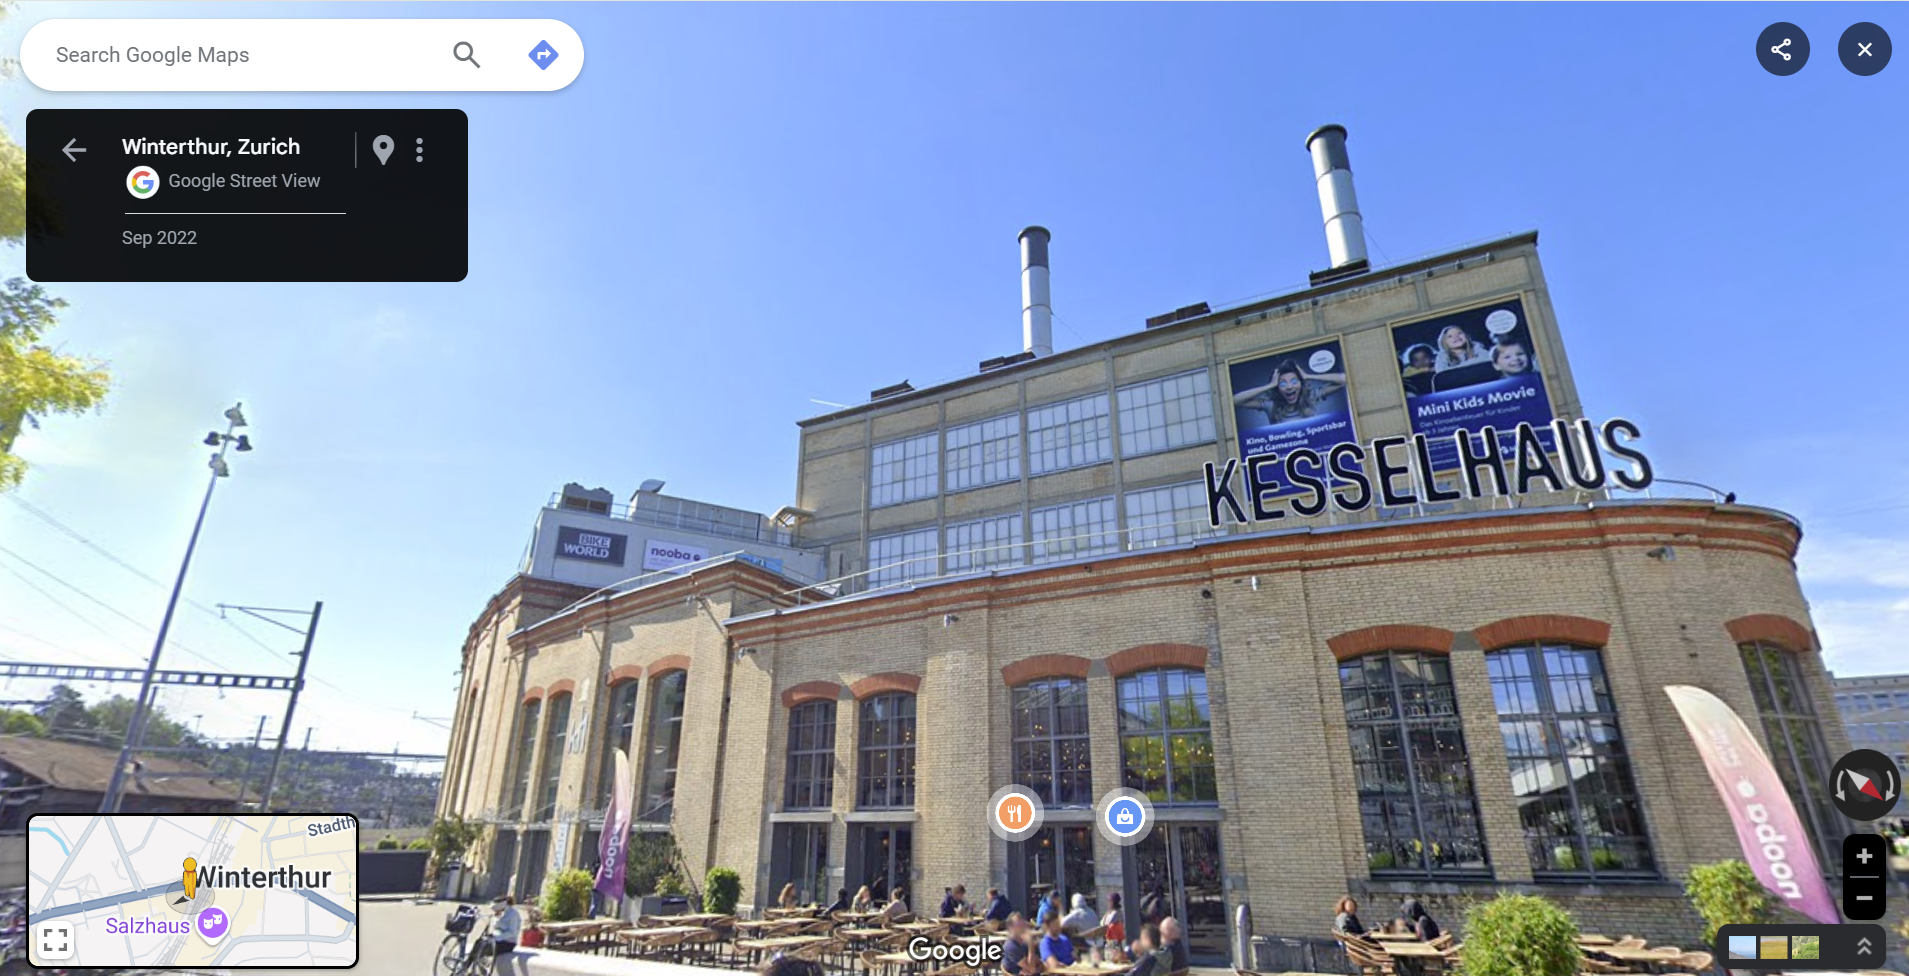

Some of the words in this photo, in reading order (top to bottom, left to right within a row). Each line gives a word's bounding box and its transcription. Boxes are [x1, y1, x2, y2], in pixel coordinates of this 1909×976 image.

[1418, 401, 1451, 418] Mini
[1453, 396, 1484, 411] Kids
[1487, 387, 1536, 404] Movie
[1485, 409, 1496, 417] für
[1497, 404, 1522, 414] Kinder
[1245, 436, 1268, 446] Kino,
[1268, 430, 1306, 442] Bowling,
[1306, 421, 1347, 435] Sportsbar
[1247, 444, 1264, 454] und
[1265, 438, 1309, 451] Gamezone
[1203, 418, 1655, 527] KESSELHAUS
[579, 533, 611, 549] BIKE
[564, 543, 610, 559] WORLD
[651, 547, 691, 560] nooba
